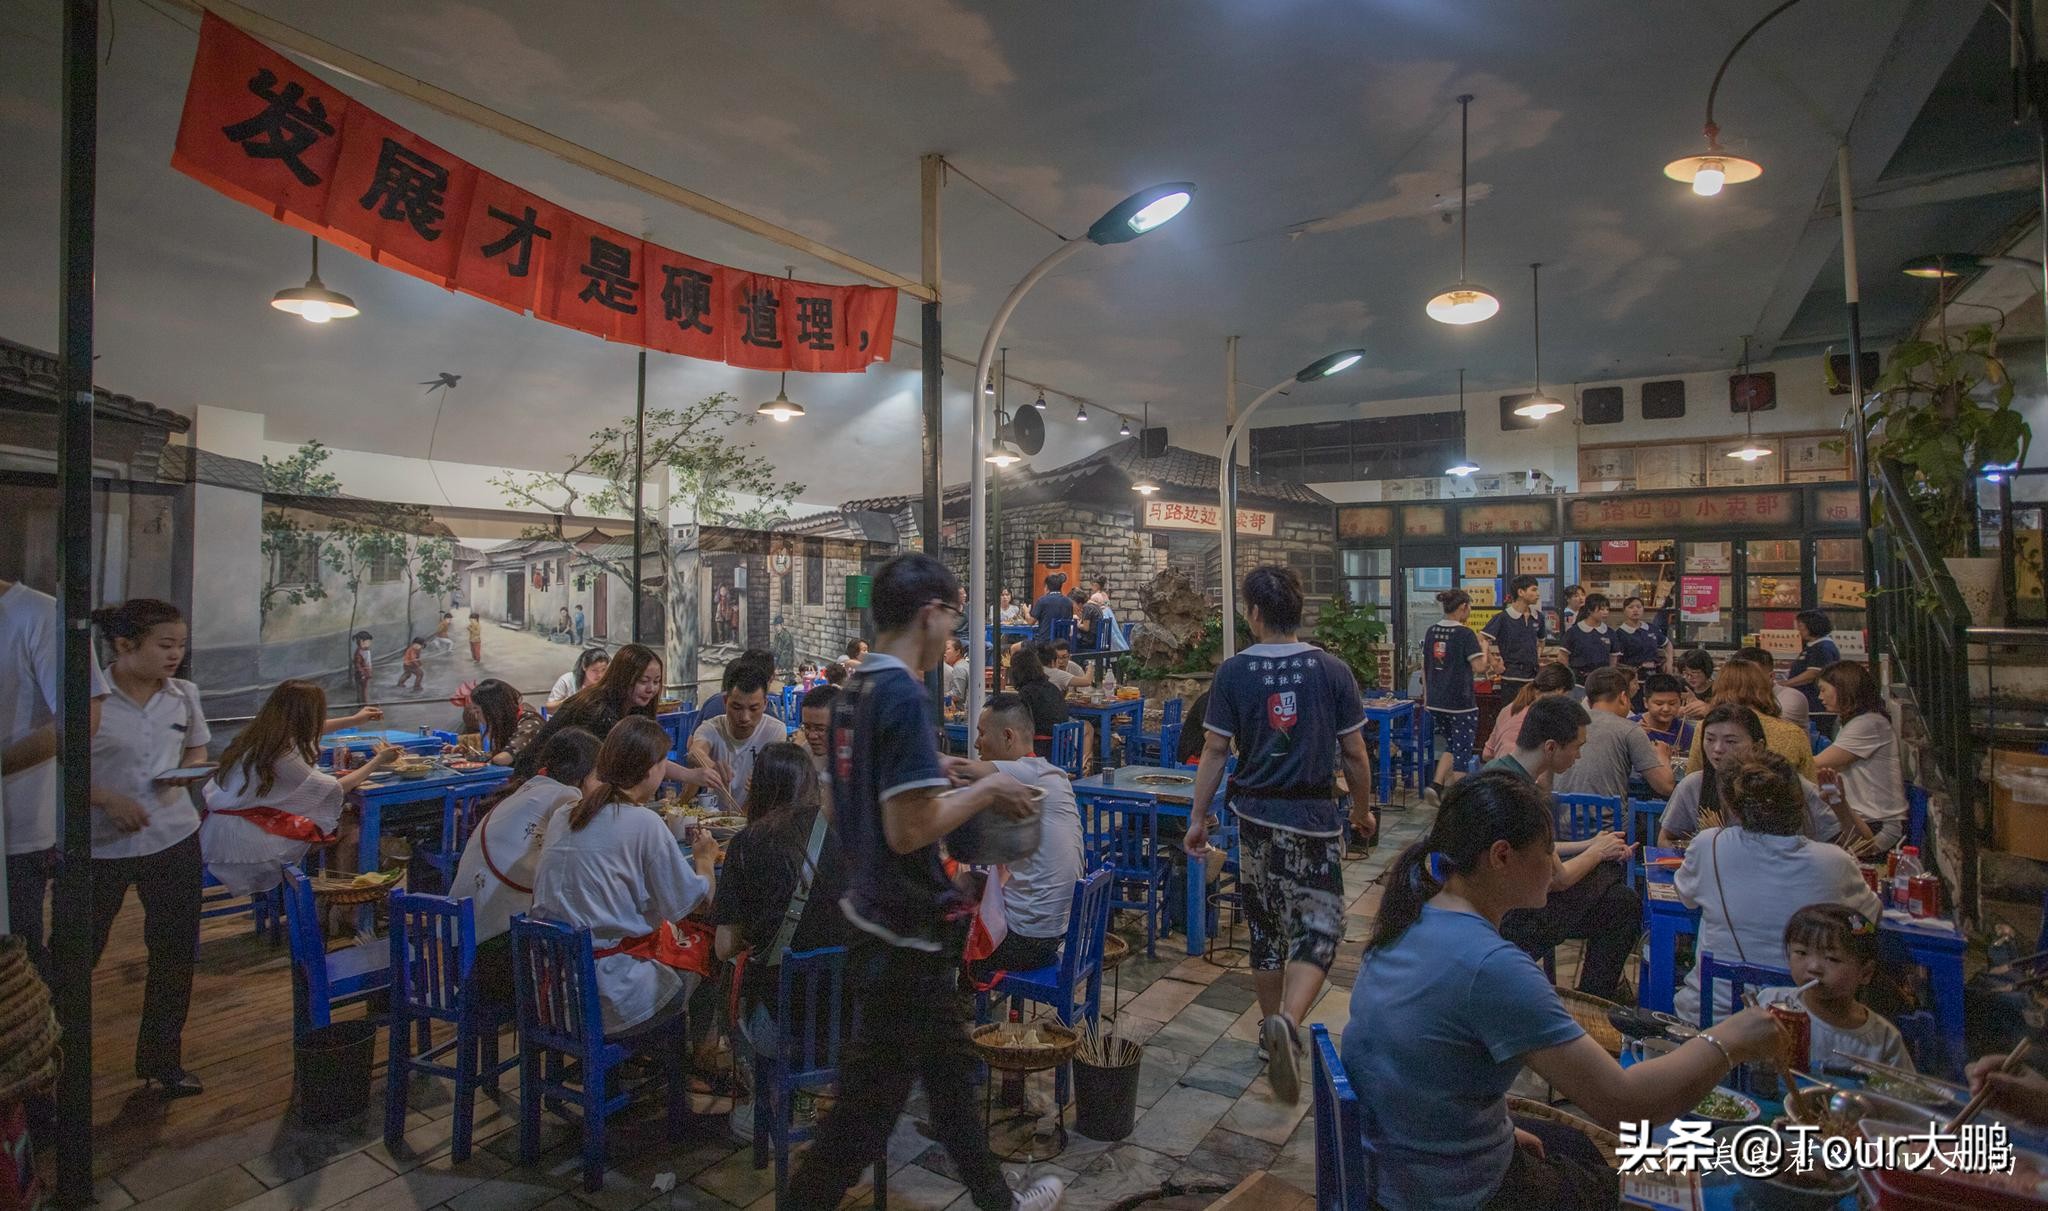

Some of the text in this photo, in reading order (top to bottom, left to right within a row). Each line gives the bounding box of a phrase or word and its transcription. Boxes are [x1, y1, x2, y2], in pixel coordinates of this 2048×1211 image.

[1148, 502, 1267, 531] 马路边边卖部
[1825, 504, 1861, 520] 烟
